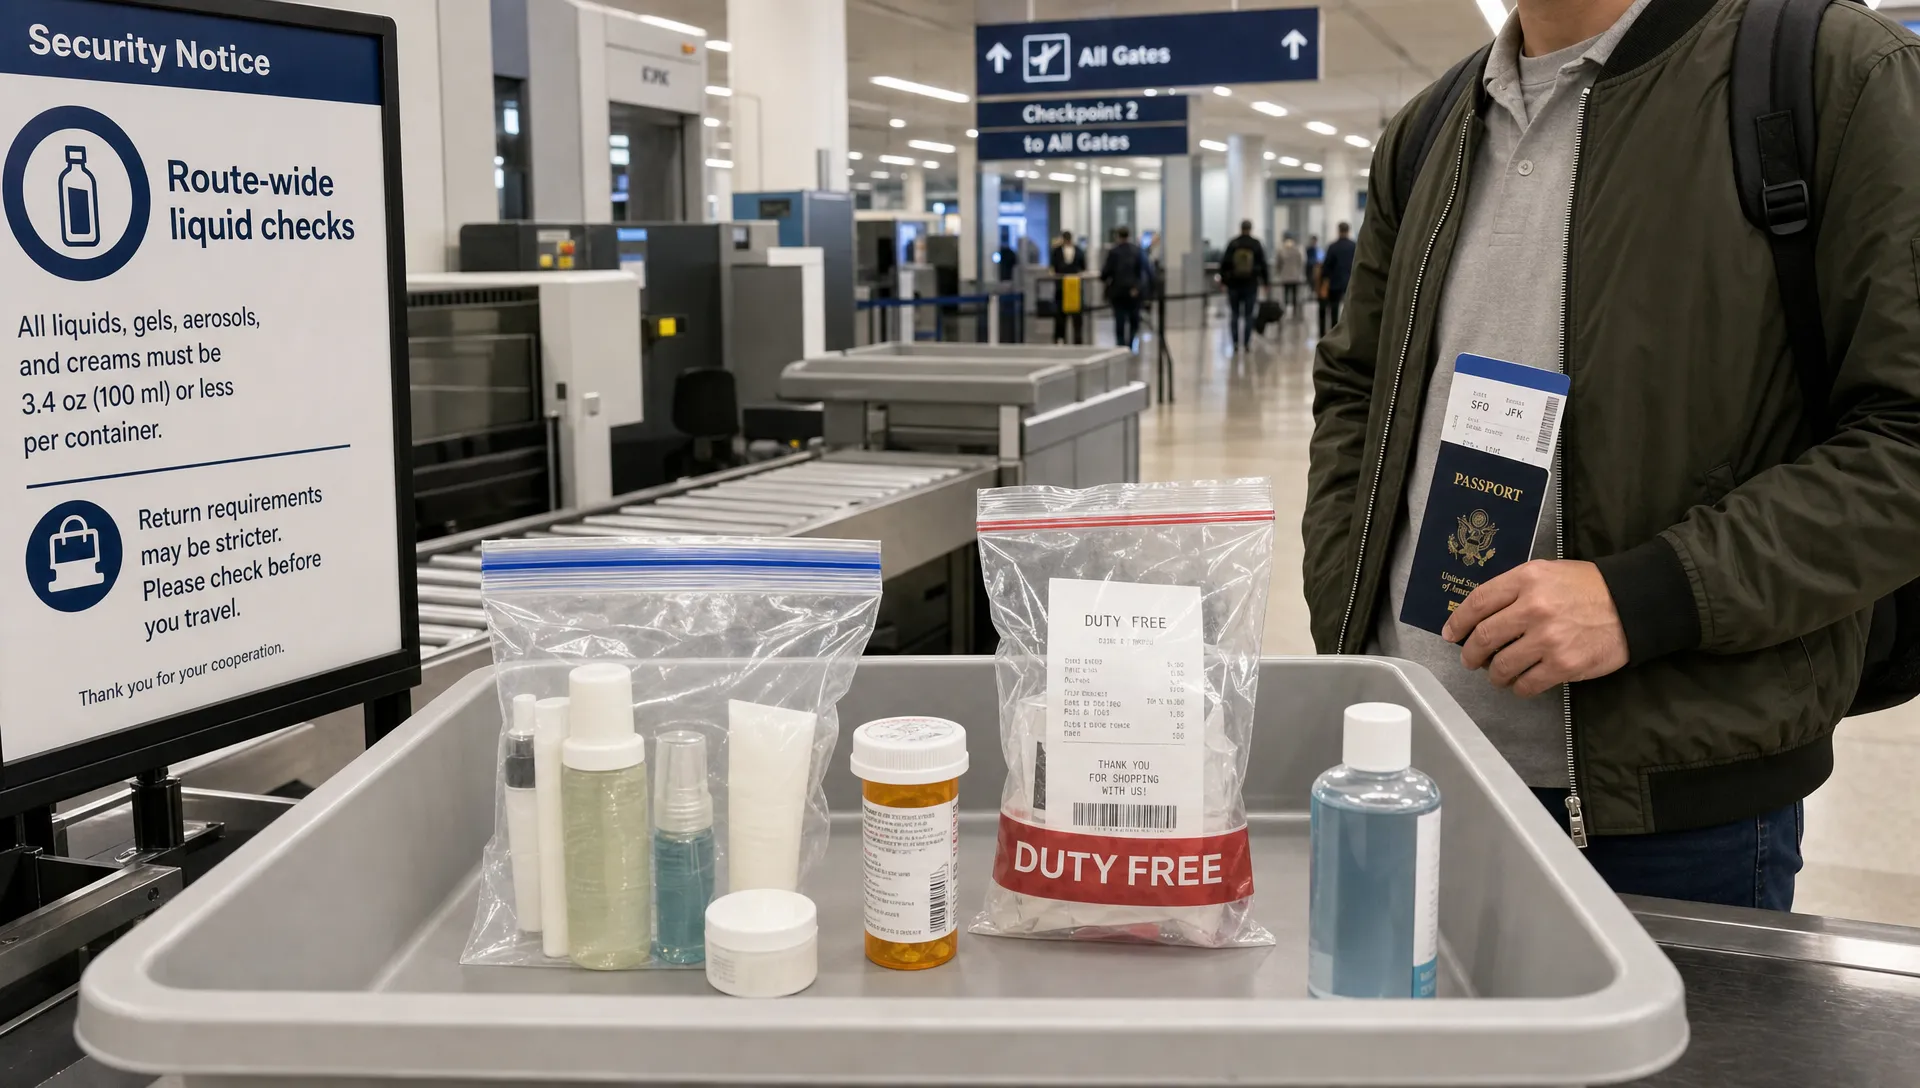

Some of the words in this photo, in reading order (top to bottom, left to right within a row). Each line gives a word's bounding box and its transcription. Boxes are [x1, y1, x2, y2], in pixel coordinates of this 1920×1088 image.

[29, 23, 166, 73] Security
[176, 39, 270, 75] Notice
[1078, 46, 1108, 68] All
[1112, 45, 1171, 66] Gates
[1022, 102, 1123, 125] Checkpoint
[1126, 101, 1139, 120] 2
[1023, 136, 1044, 153] to
[1048, 133, 1073, 151] All
[1076, 133, 1130, 151] Gates
[168, 160, 333, 196] Route-wide
[171, 207, 253, 248] liquid
[261, 209, 354, 240] checks
[18, 314, 45, 338] All
[52, 311, 126, 340] liquids,
[134, 309, 177, 337] gels,
[183, 306, 260, 329] aerosols,
[20, 352, 59, 376] and
[67, 353, 140, 373] creams
[147, 345, 193, 367] must
[199, 343, 221, 363] be
[22, 391, 56, 415] 3.4
[63, 392, 87, 411] oz
[93, 385, 134, 413] (100
[141, 380, 170, 406] ml)
[176, 385, 194, 400] or
[199, 378, 234, 398] less
[1471, 400, 1489, 411] SFO
[1505, 408, 1524, 419] JFK
[24, 434, 58, 459] per
[65, 421, 162, 449] container.
[1454, 472, 1523, 502] PASSPORT
[139, 507, 201, 530] Return
[207, 486, 322, 521] requirements
[141, 543, 181, 566] may
[188, 537, 210, 557] be
[216, 528, 282, 553] stricter.
[143, 575, 205, 601] Please
[211, 562, 263, 589] check
[268, 551, 321, 576] before
[145, 616, 179, 642] you
[184, 598, 241, 629] travel.
[1085, 615, 1121, 627] DUTY
[1132, 616, 1167, 629] FREE
[79, 682, 123, 706] Thank
[127, 677, 152, 698] you
[157, 671, 175, 686] for
[179, 663, 207, 684] your
[212, 642, 285, 672] cooperation.
[1089, 773, 1107, 782] FOR
[1113, 774, 1159, 784] SHOPPING
[1098, 760, 1127, 770] THANK
[1133, 760, 1150, 770] YOU
[1102, 786, 1125, 796] WITH
[1131, 787, 1147, 796] US!
[1014, 840, 1118, 885] DUTY
[1128, 853, 1222, 887] FREE
